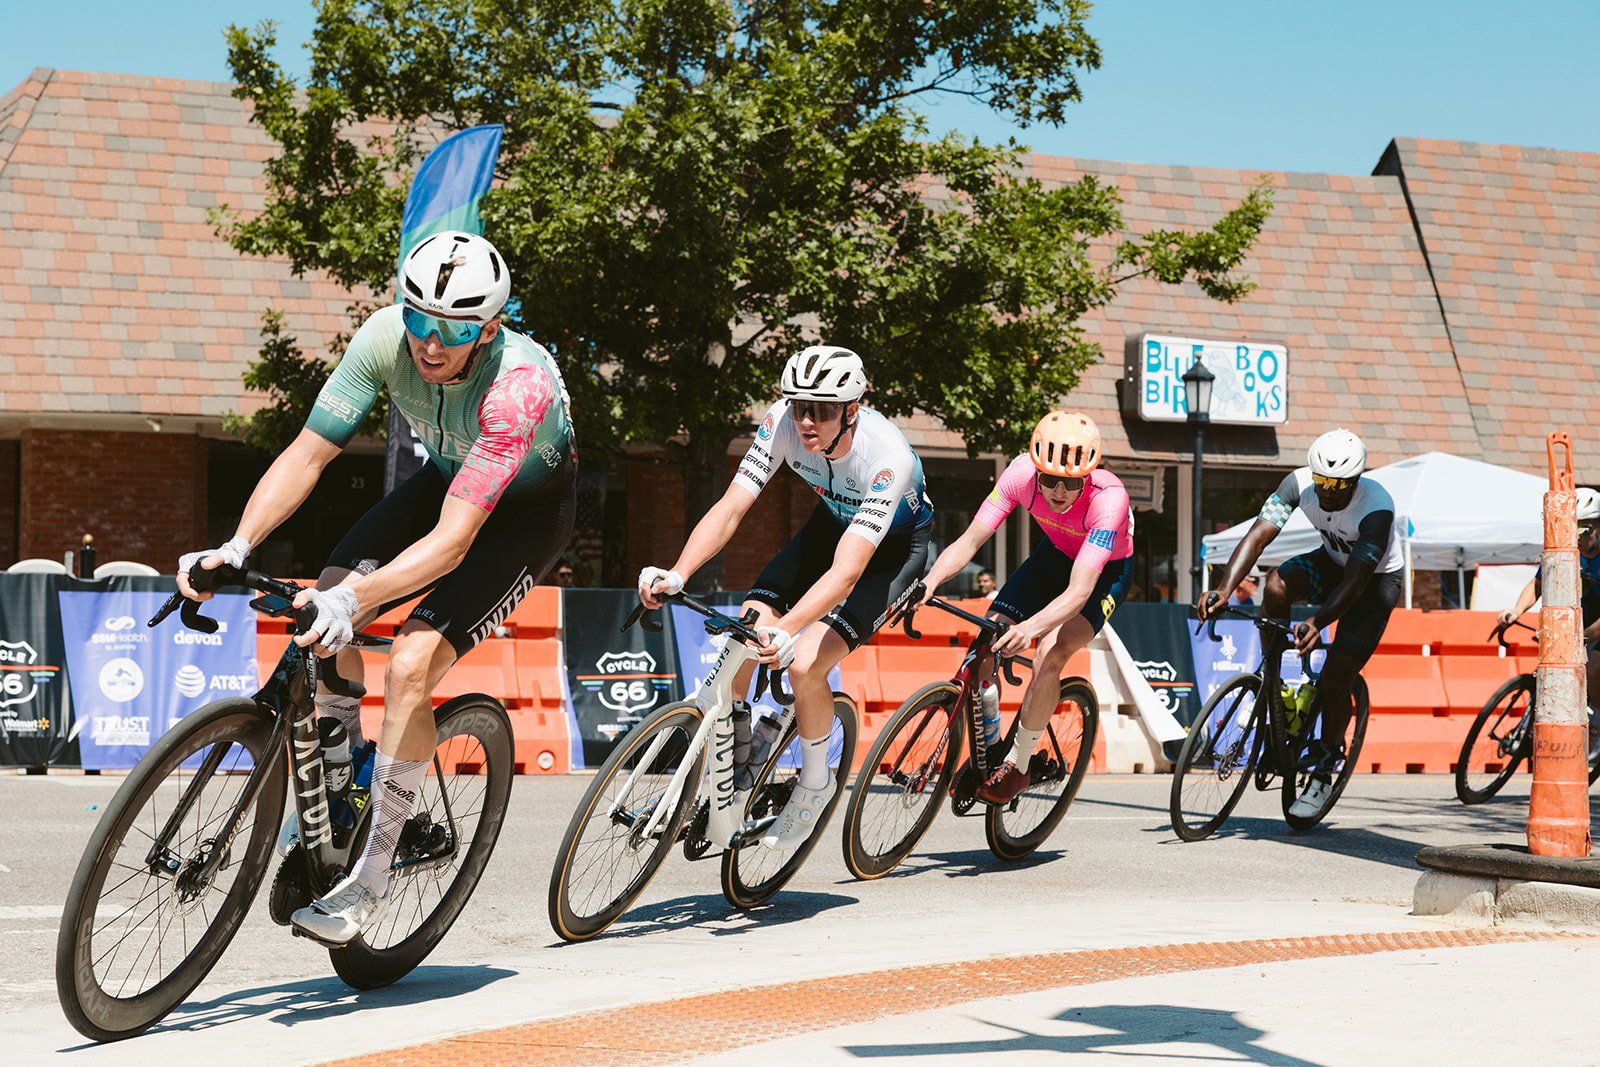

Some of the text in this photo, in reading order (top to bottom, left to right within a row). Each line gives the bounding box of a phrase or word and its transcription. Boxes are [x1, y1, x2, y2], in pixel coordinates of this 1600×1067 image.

[1236, 346, 1282, 417] BOOKS
[1145, 375, 1189, 414] BIR
[744, 453, 772, 475] ERGE
[743, 469, 765, 489] RACIN
[823, 489, 866, 508] RACIN
[863, 497, 893, 508] REK
[854, 519, 883, 534] RACING
[747, 588, 780, 599] ERGE
[471, 574, 534, 648] UNITED
[828, 611, 859, 639] VERGE
[174, 630, 223, 646] devon
[606, 660, 648, 674] CYCLE
[705, 646, 730, 687] FACTOR
[1143, 669, 1170, 681] YCLE
[209, 675, 249, 691] AT&T
[610, 681, 648, 702] 66
[94, 716, 150, 733] TRUST
[438, 712, 499, 738] YPER
[715, 714, 735, 812] FACTOR
[293, 710, 332, 850] FACTOR
[220, 810, 247, 859] FACTOR
